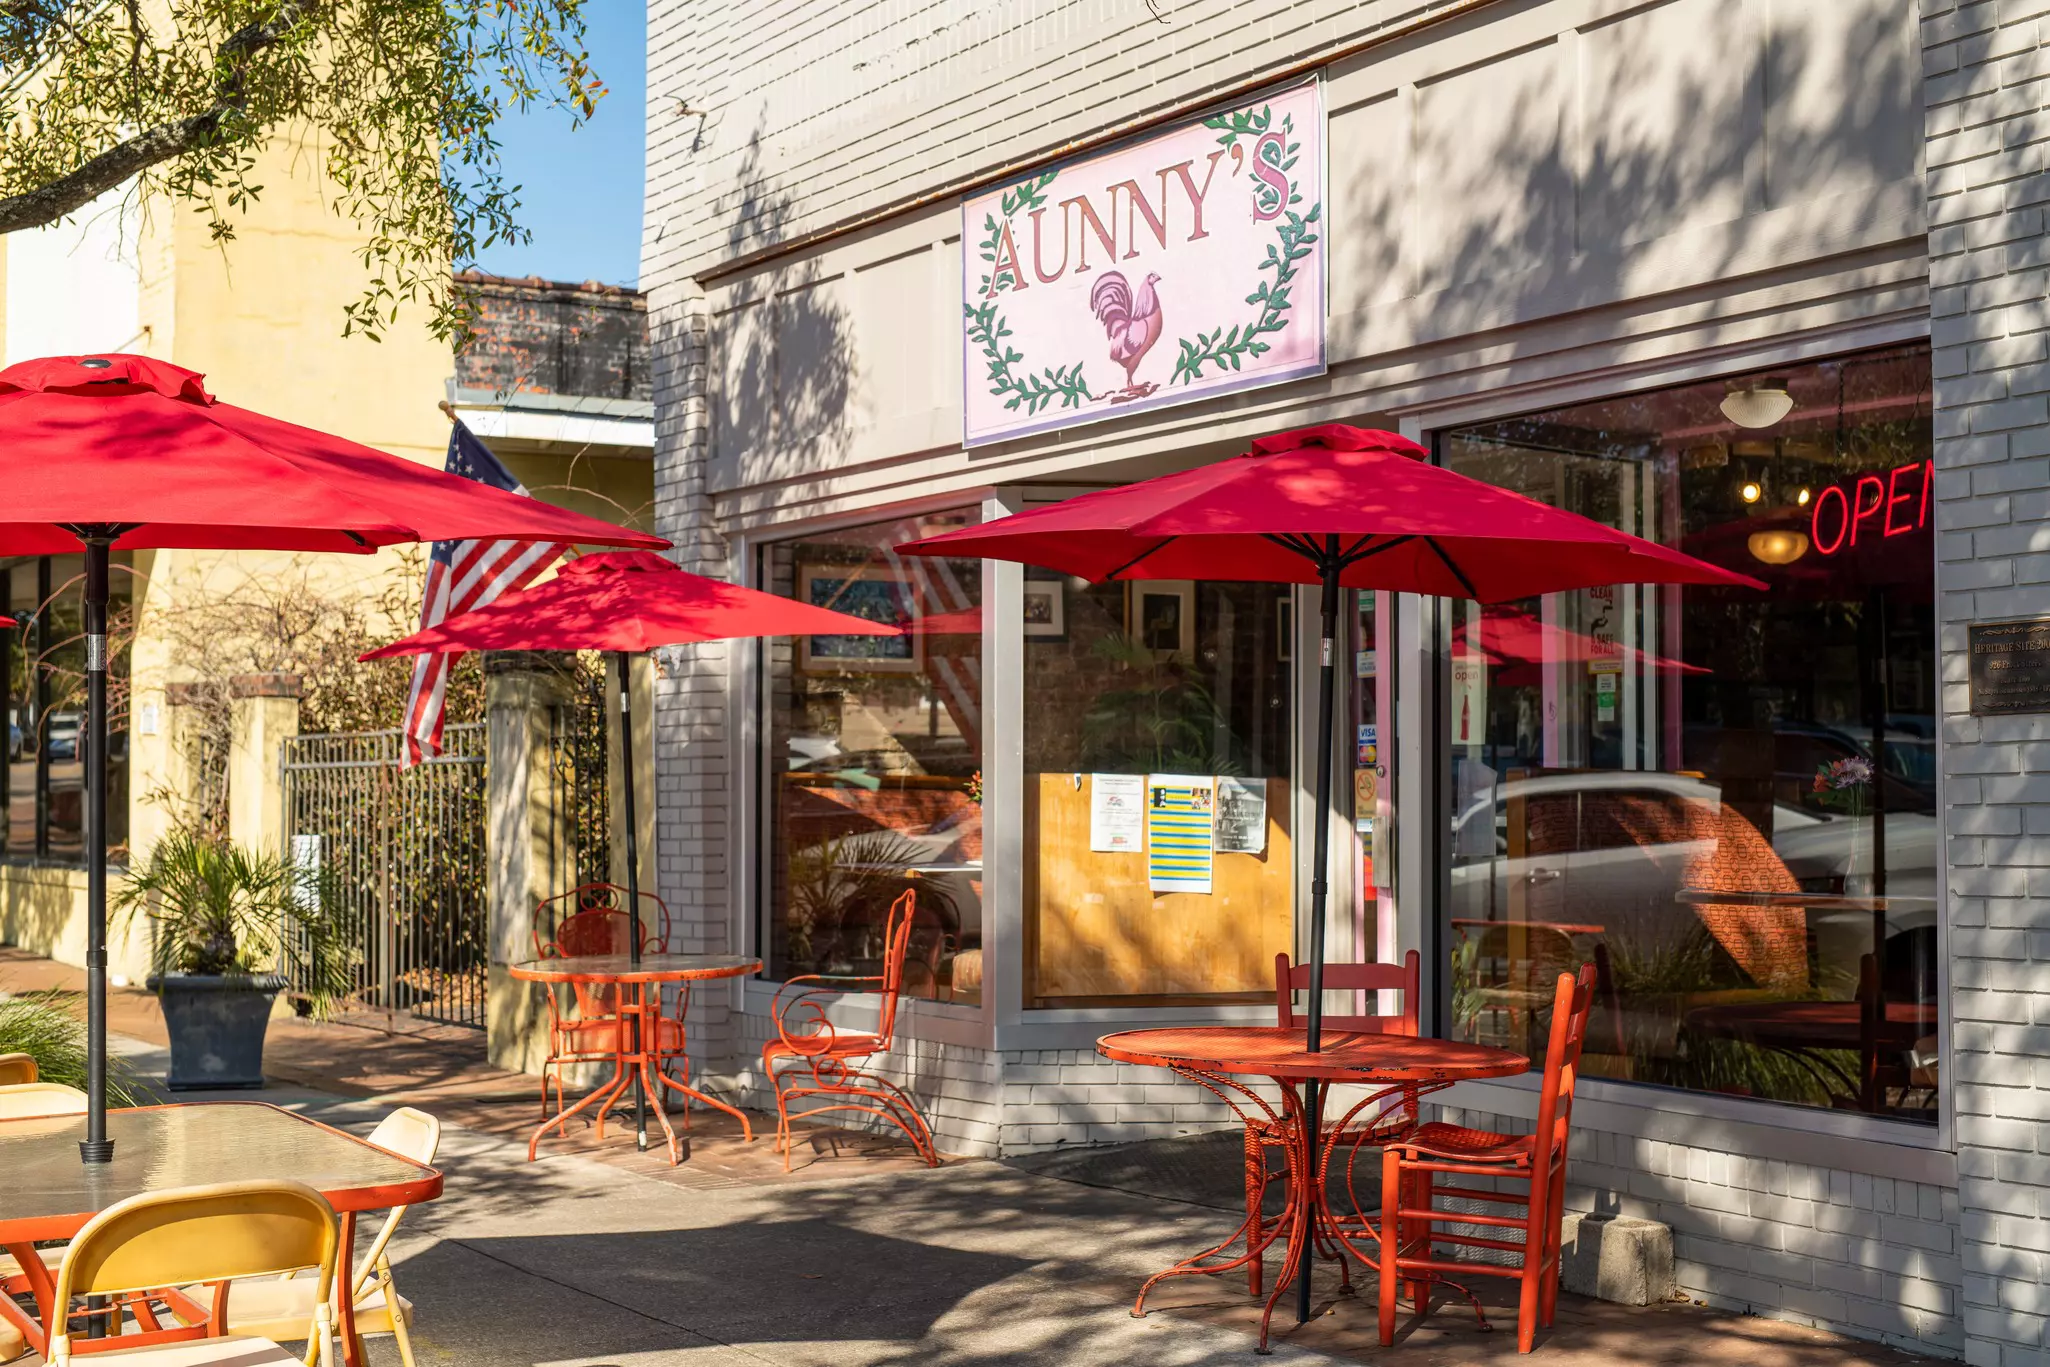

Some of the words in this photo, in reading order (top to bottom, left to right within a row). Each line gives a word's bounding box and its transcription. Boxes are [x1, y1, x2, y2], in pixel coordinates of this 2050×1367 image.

[986, 129, 1292, 300] AUNNY'S
[1590, 586, 1613, 599] CLEAN
[1596, 632, 1614, 644] SAFE
[1590, 644, 1603, 655] FOR
[1603, 644, 1615, 655] ALL
[1975, 642, 2013, 653] HERITAGE
[1455, 672, 1478, 682] open
[1360, 727, 1376, 738] VISA
